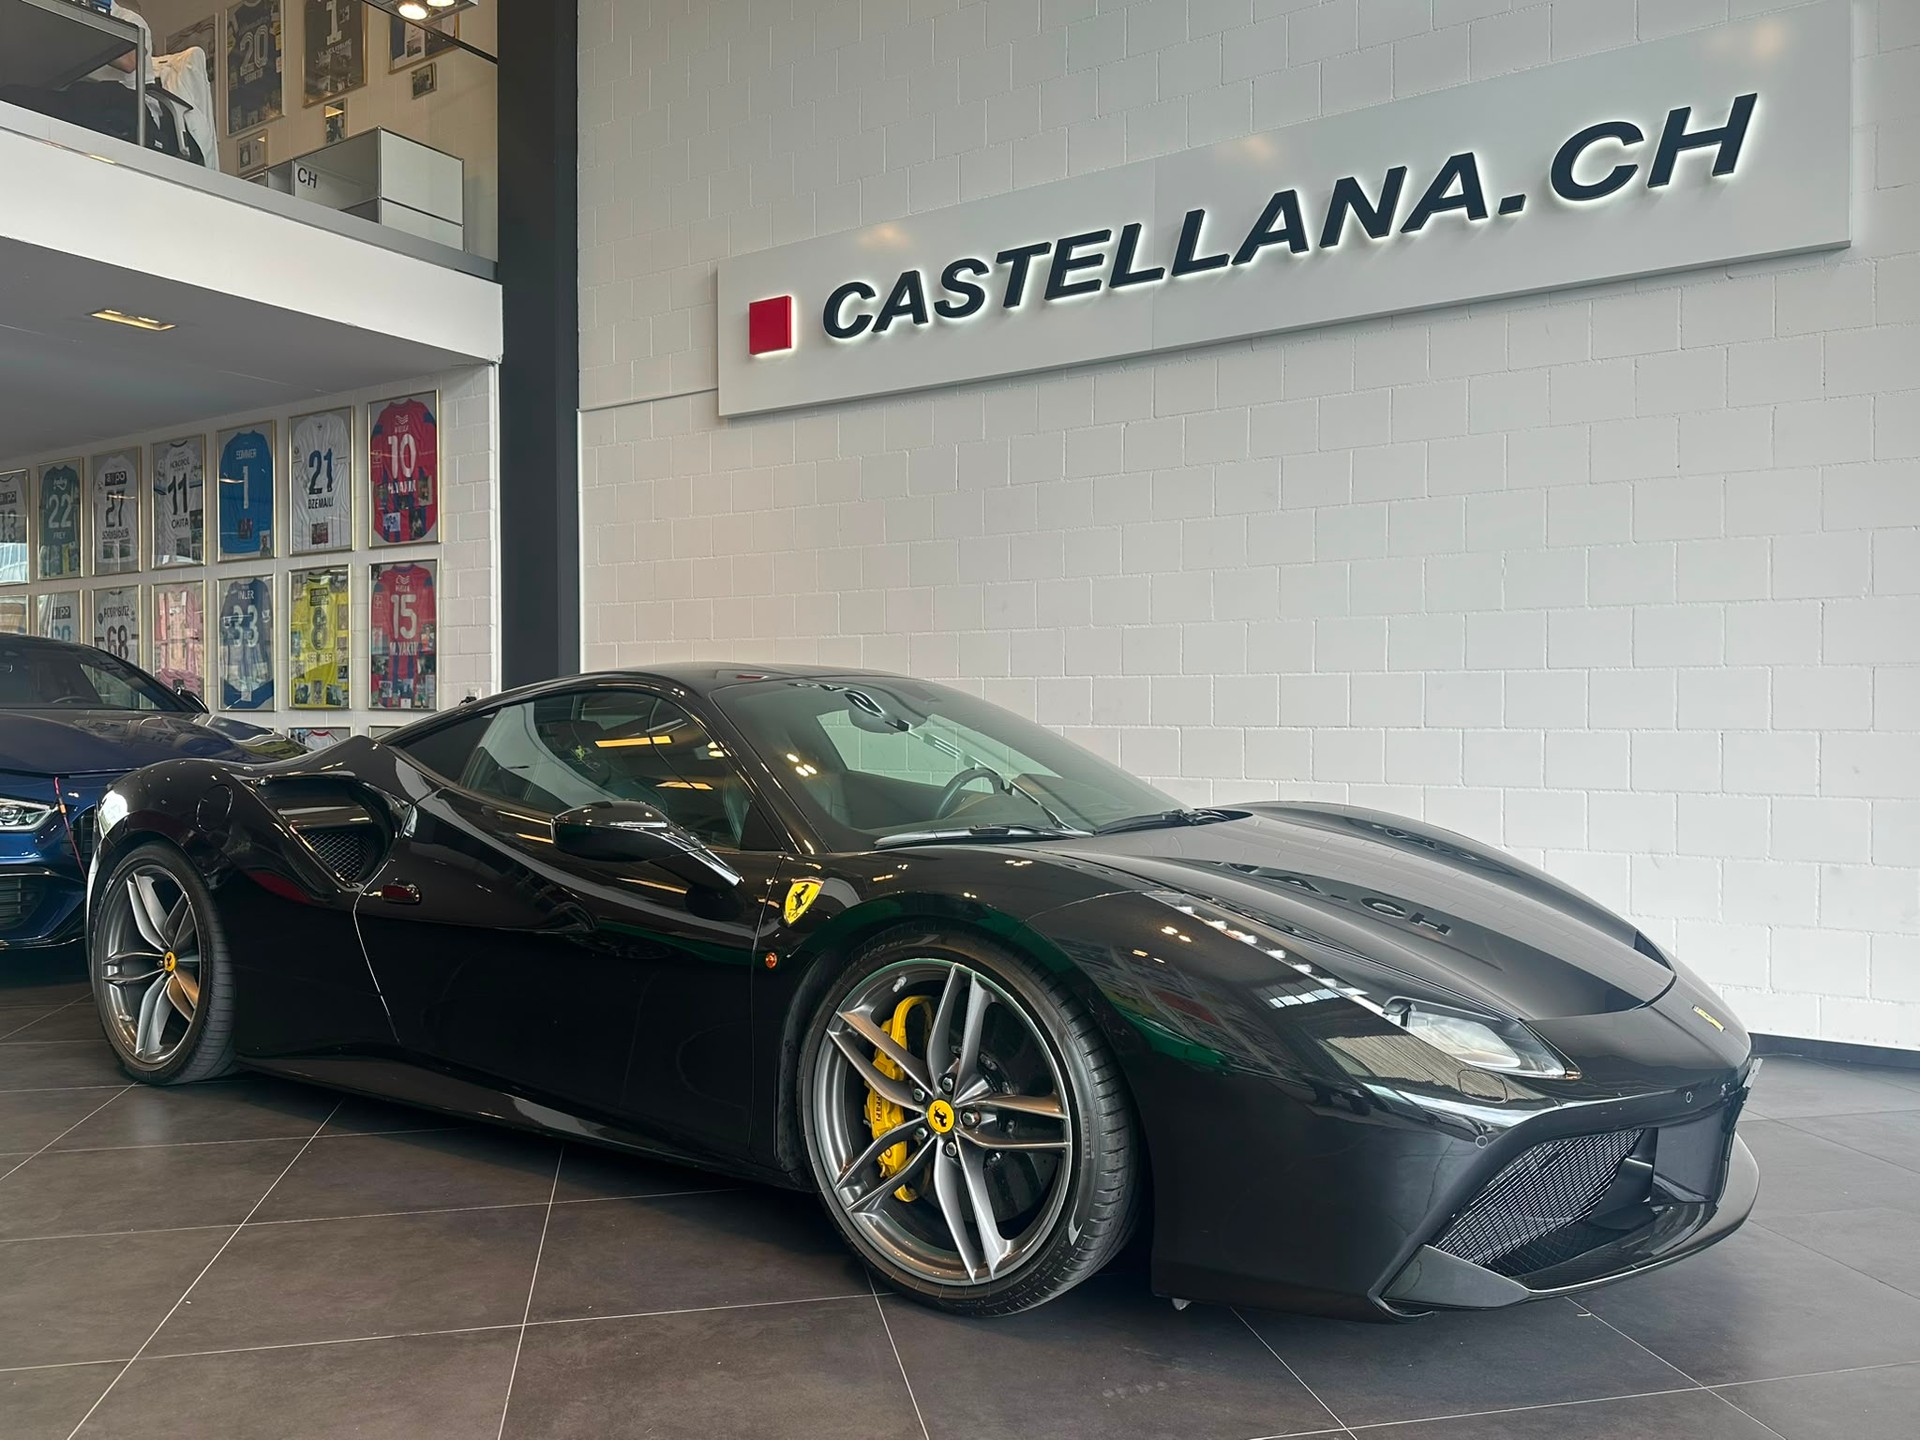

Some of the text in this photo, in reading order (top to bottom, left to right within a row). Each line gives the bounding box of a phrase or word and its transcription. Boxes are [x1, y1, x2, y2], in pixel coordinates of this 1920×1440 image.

[240, 24, 268, 76] 20
[298, 167, 317, 188] CH
[823, 93, 1757, 338] CASTELLANA.CH
[309, 448, 332, 495] 21
[388, 433, 416, 479] 10
[106, 489, 124, 528] 27
[168, 473, 187, 515] 11
[243, 465, 249, 509] 1
[48, 494, 72, 528] 22
[311, 606, 328, 650] 8
[391, 594, 417, 639] 15
